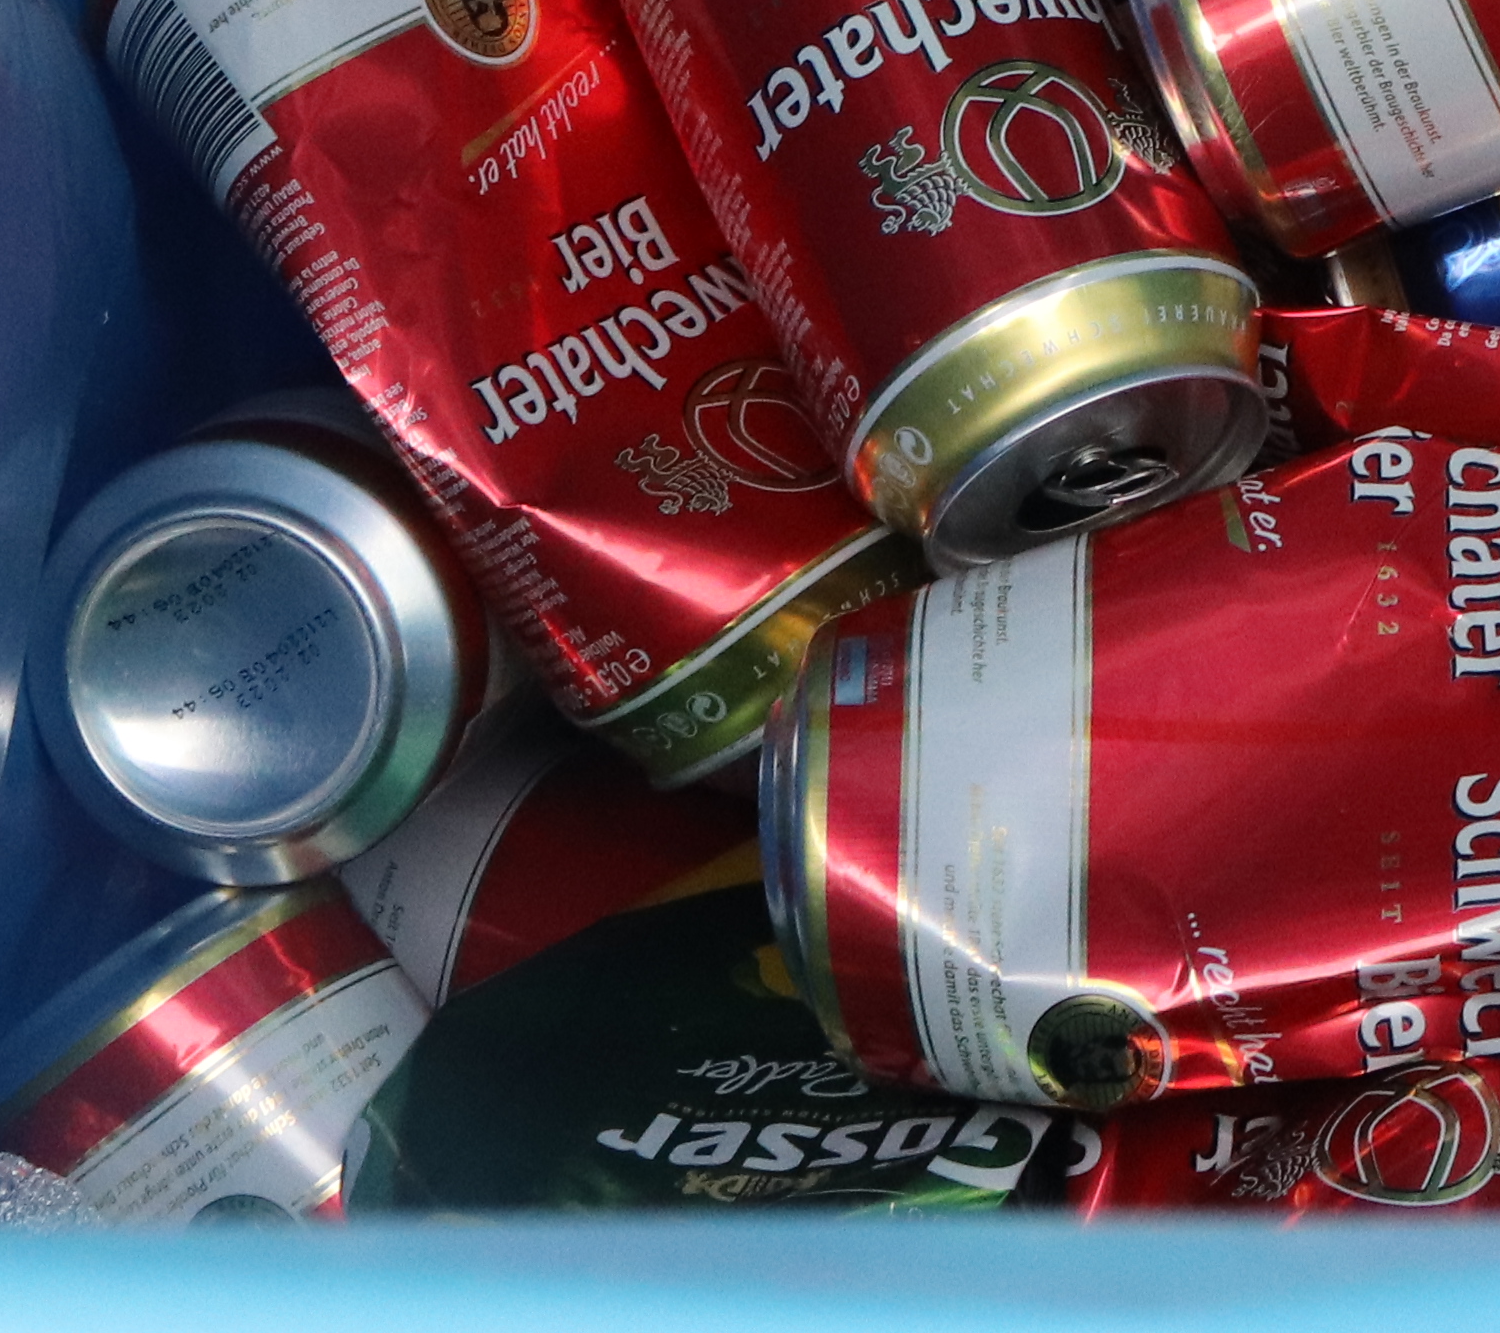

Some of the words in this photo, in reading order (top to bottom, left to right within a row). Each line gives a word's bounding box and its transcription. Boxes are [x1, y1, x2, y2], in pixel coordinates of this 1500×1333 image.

[207, 13, 231, 34] her
[1337, 46, 1387, 133] weltberühmt.
[1393, 58, 1412, 82] der
[499, 117, 549, 181] hat
[468, 160, 501, 196] er.
[550, 194, 681, 294] Bier
[945, 313, 1122, 417] SCHWECHAT
[1247, 510, 1286, 555] er.
